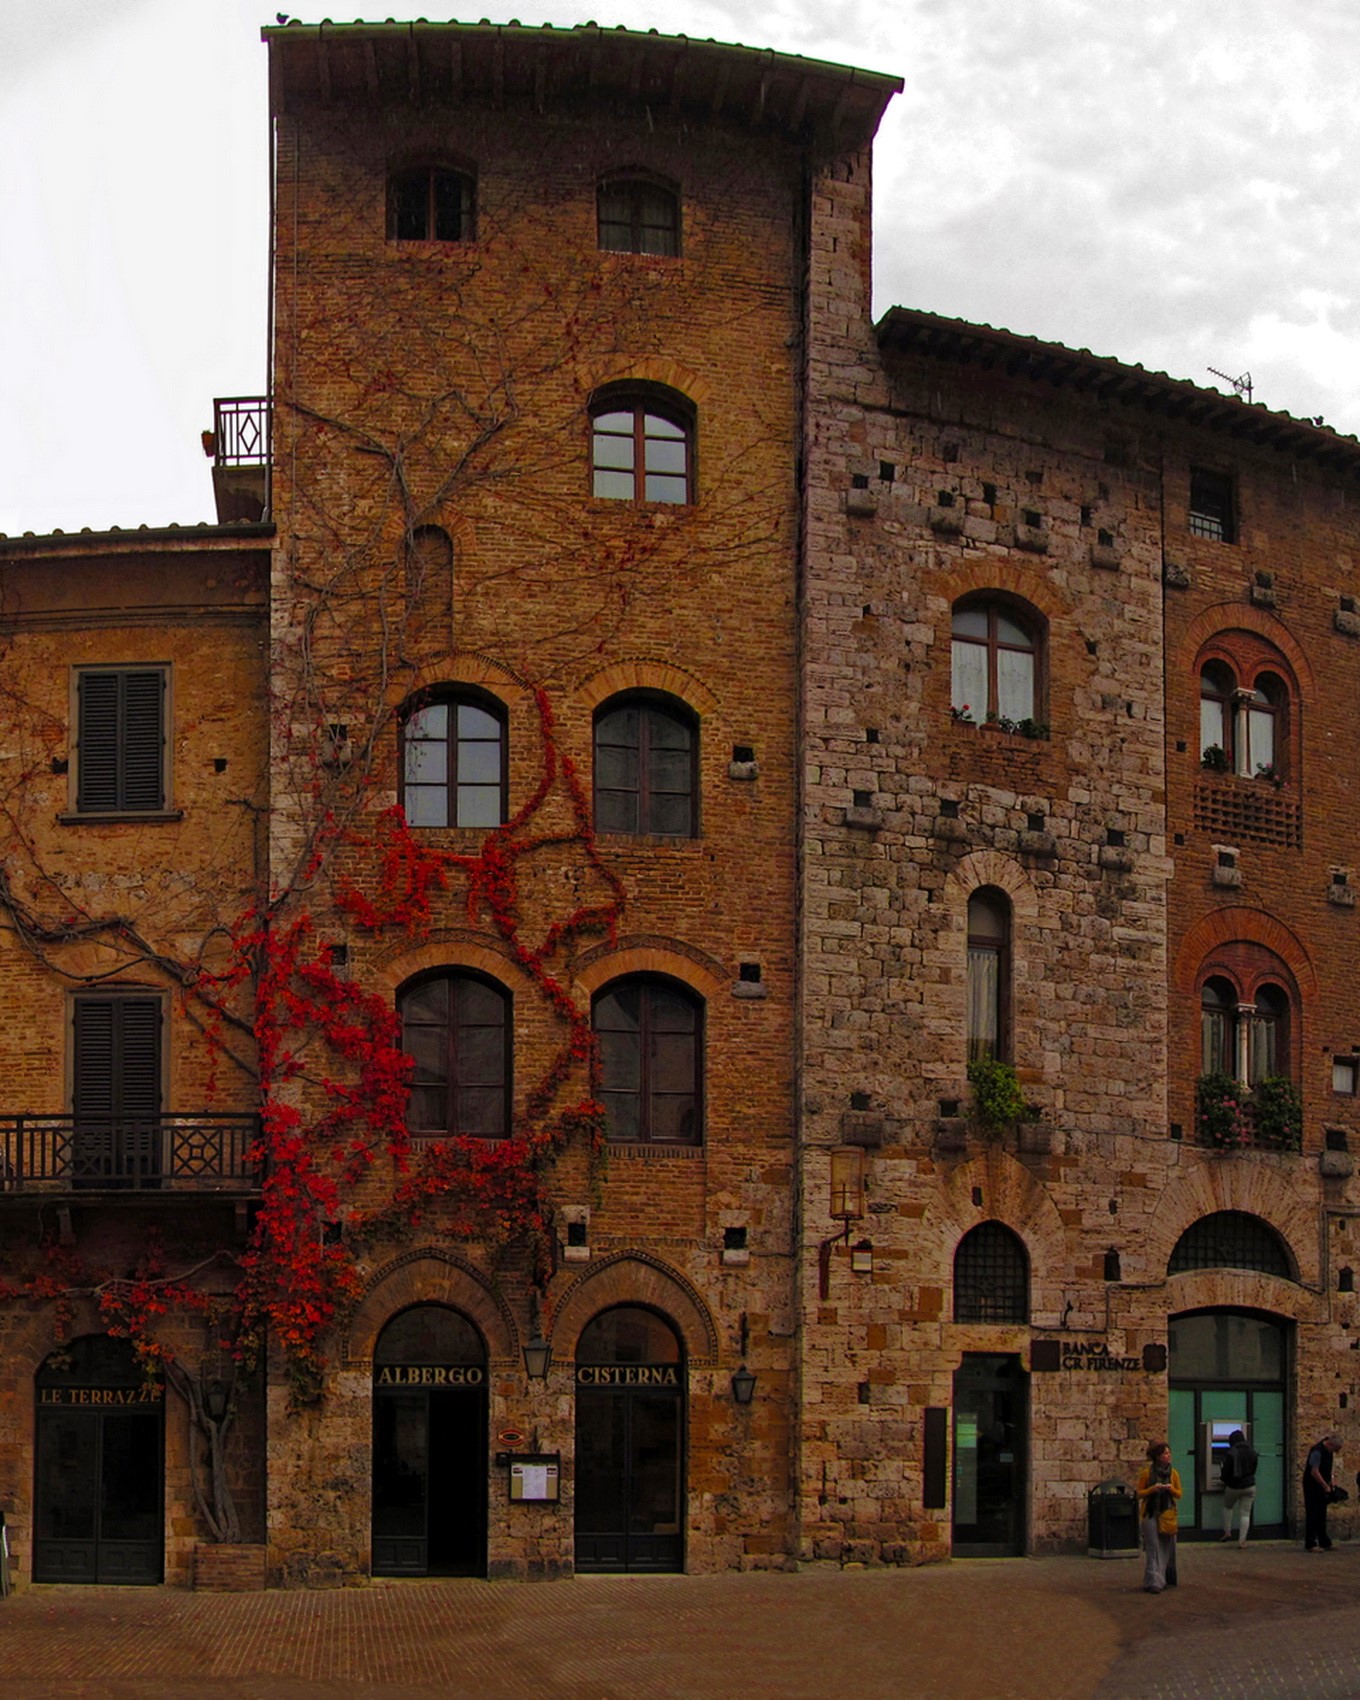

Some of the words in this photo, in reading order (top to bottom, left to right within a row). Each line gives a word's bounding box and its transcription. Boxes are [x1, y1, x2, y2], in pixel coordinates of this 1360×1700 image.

[1063, 1342, 1109, 1356] BANCA
[1063, 1357, 1083, 1370] CR
[1087, 1357, 1141, 1370] FIRENZE
[377, 1366, 483, 1384] ALBERGO
[577, 1366, 679, 1384] CISTERNA
[40, 1388, 62, 1404] LE
